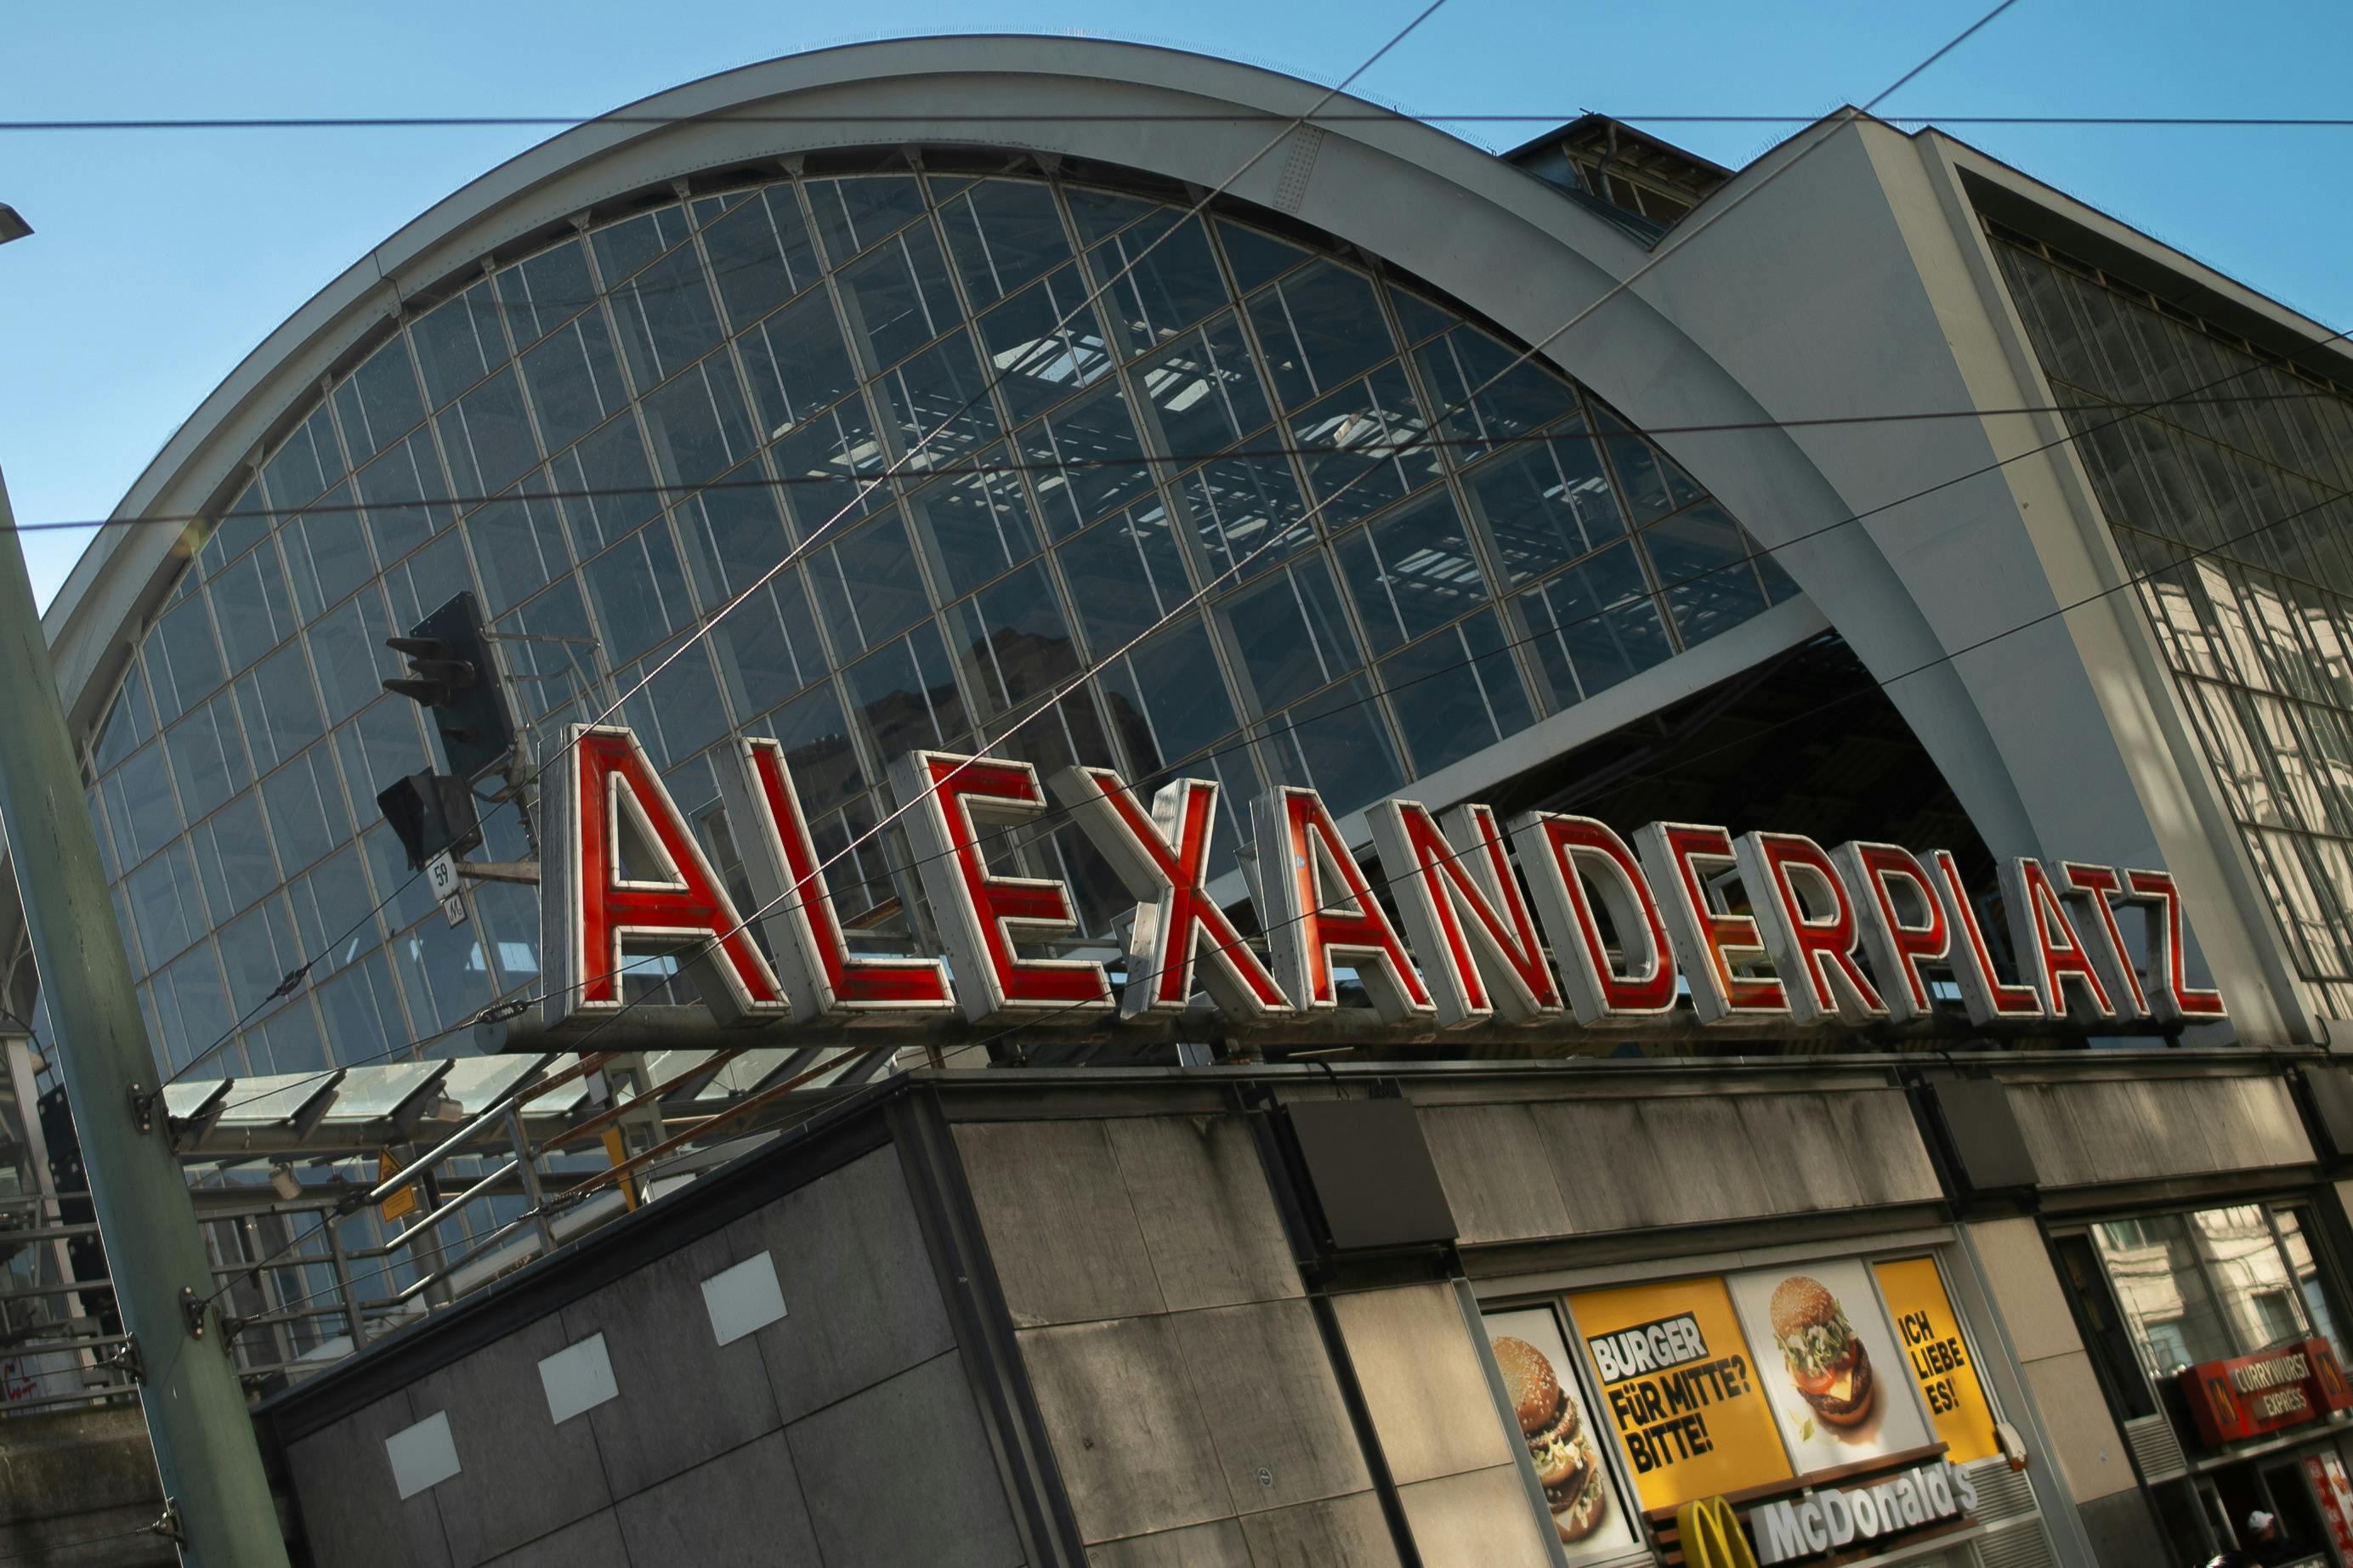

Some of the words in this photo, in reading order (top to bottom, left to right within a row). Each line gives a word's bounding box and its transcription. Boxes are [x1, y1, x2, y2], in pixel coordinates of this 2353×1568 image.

[434, 862, 449, 887] 59
[541, 722, 2227, 1018] ALEXANDERPLATZ
[1589, 1316, 1708, 1382] BURGER
[1897, 1310, 1935, 1347] ICH
[1910, 1337, 1965, 1381] LIEBE
[2234, 1353, 2310, 1394] CURRYWURST
[1658, 1353, 1752, 1415] MITTE?
[1925, 1378, 1960, 1416] ES!
[2262, 1388, 2308, 1417] EXPRESS
[1624, 1412, 1715, 1475] BITTE!
[1749, 1460, 1979, 1566] McDonald's
